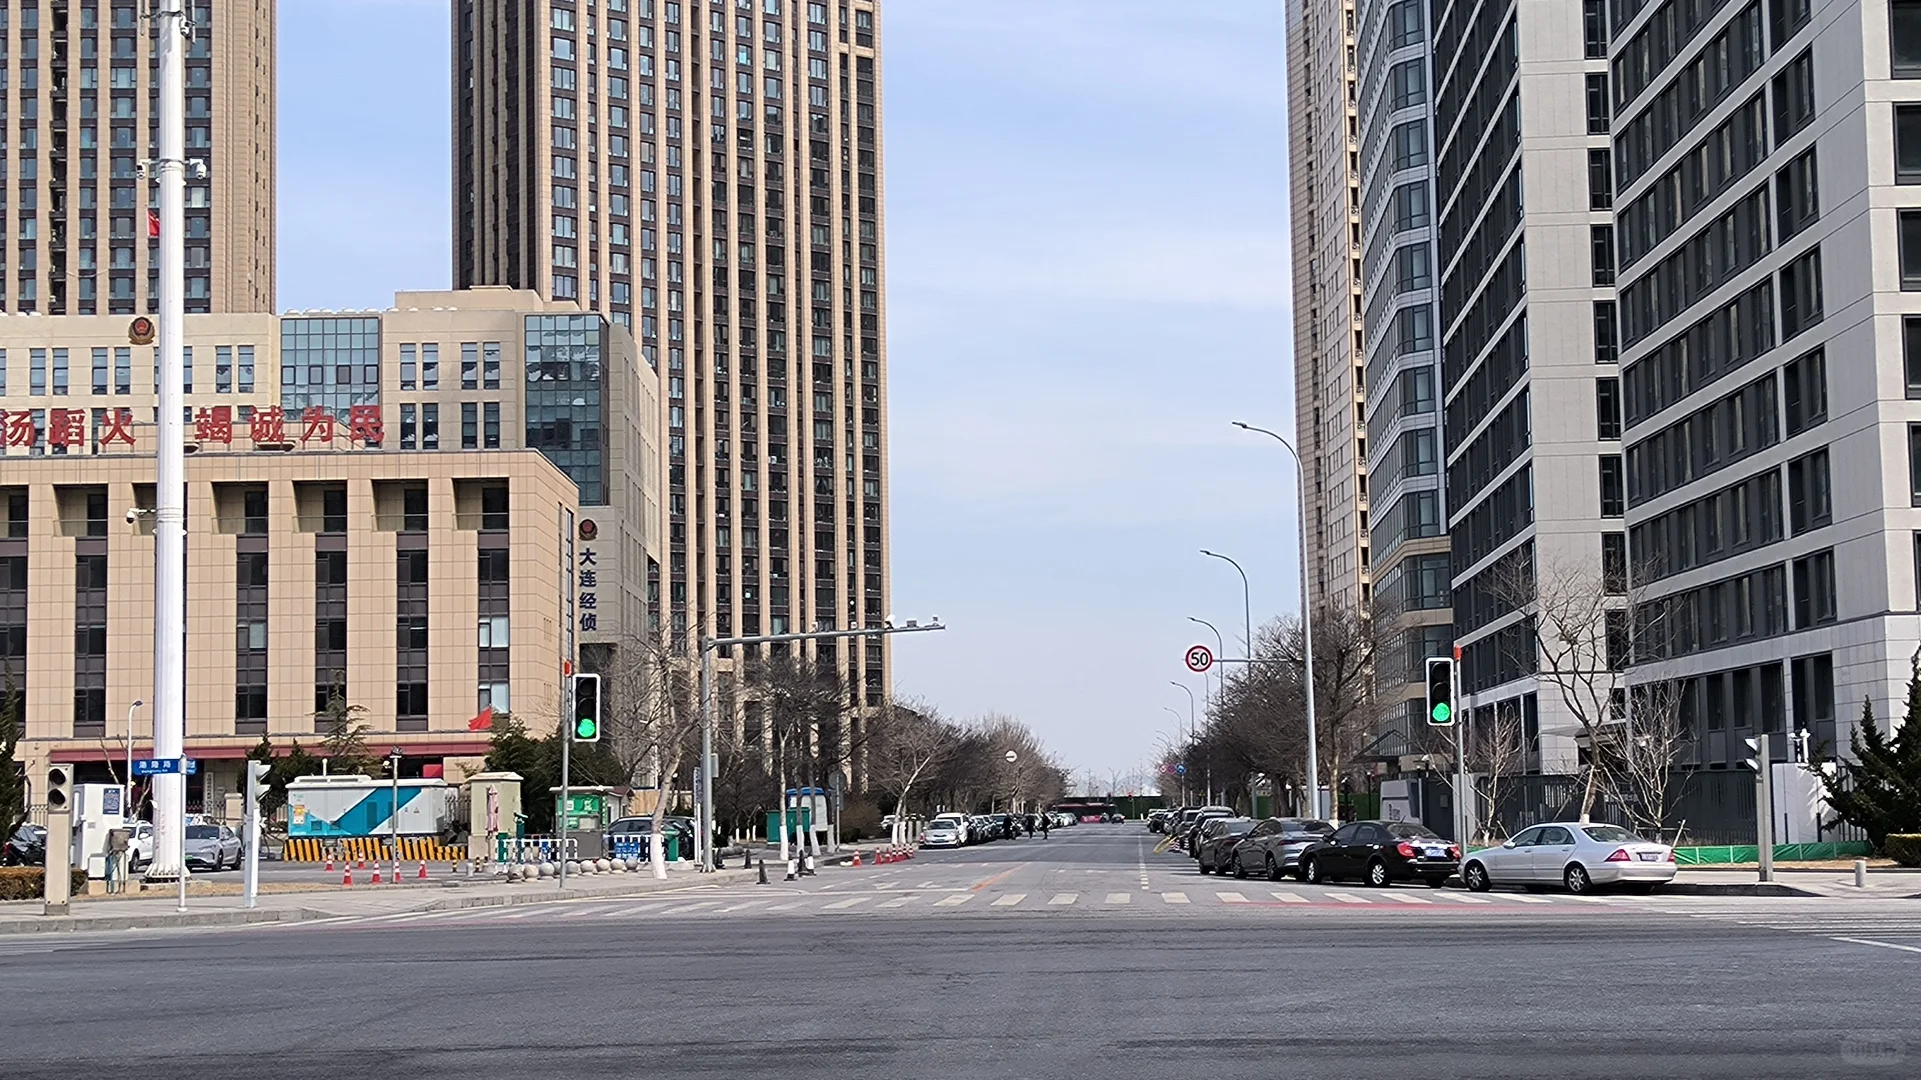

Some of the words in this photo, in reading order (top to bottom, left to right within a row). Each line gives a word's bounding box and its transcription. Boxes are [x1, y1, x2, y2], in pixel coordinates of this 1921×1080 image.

[0, 408, 136, 448] 汤蹈火
[195, 405, 385, 444] 竭诚为民
[579, 547, 597, 631] 大连经侦
[1191, 652, 1208, 666] 50
